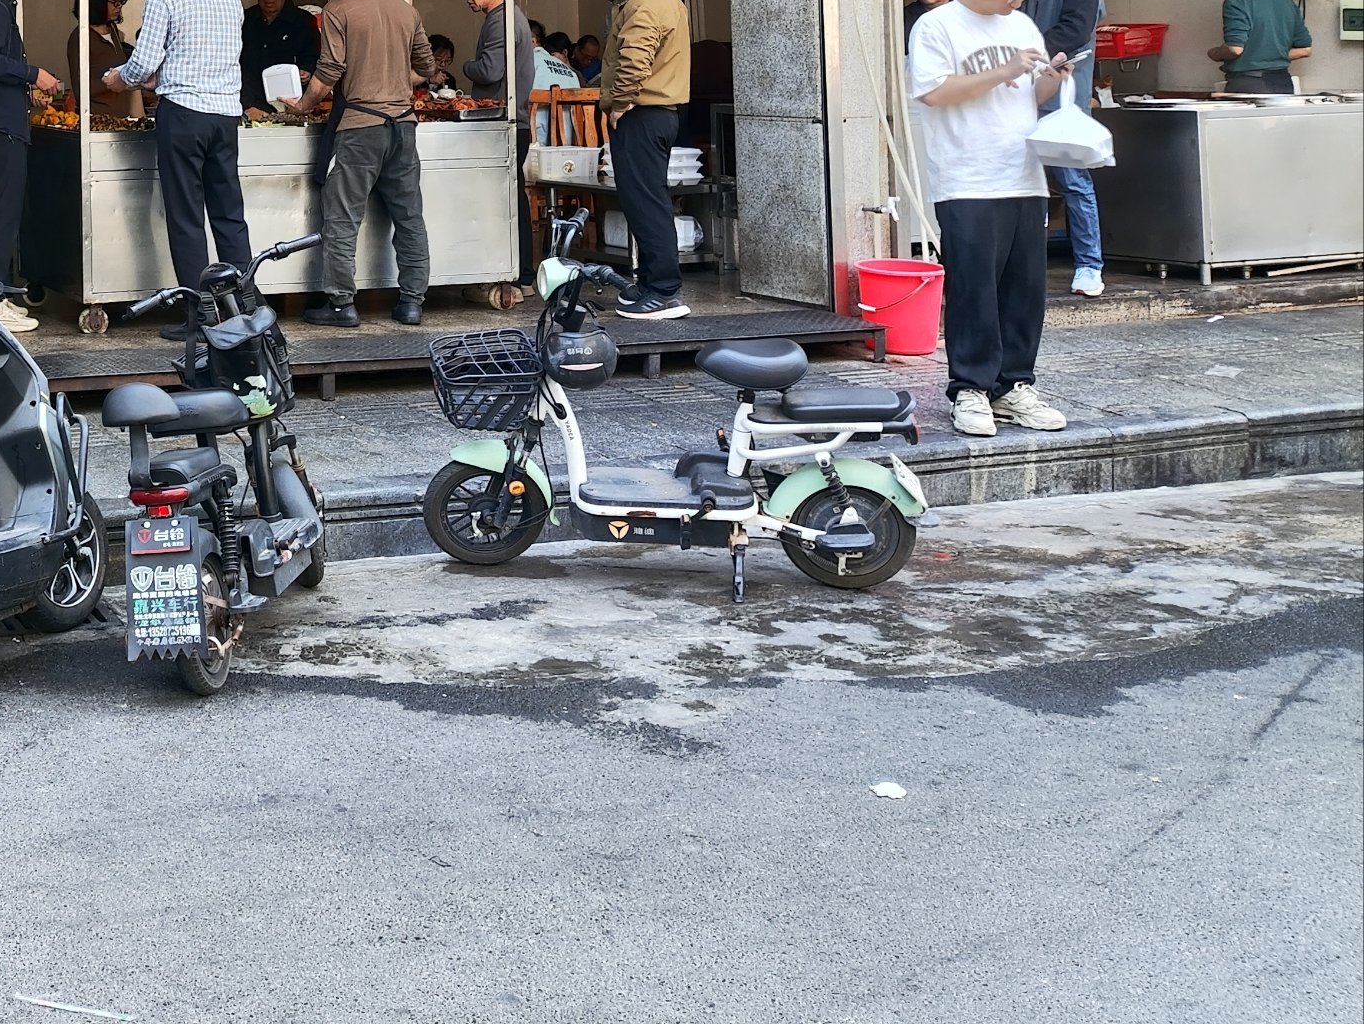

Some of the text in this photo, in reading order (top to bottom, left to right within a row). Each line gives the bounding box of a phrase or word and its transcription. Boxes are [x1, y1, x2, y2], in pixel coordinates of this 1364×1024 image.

[547, 66, 574, 78] TREES
[564, 420, 575, 441] YADEA
[154, 527, 185, 542] 台铃
[154, 563, 198, 592] 台铃
